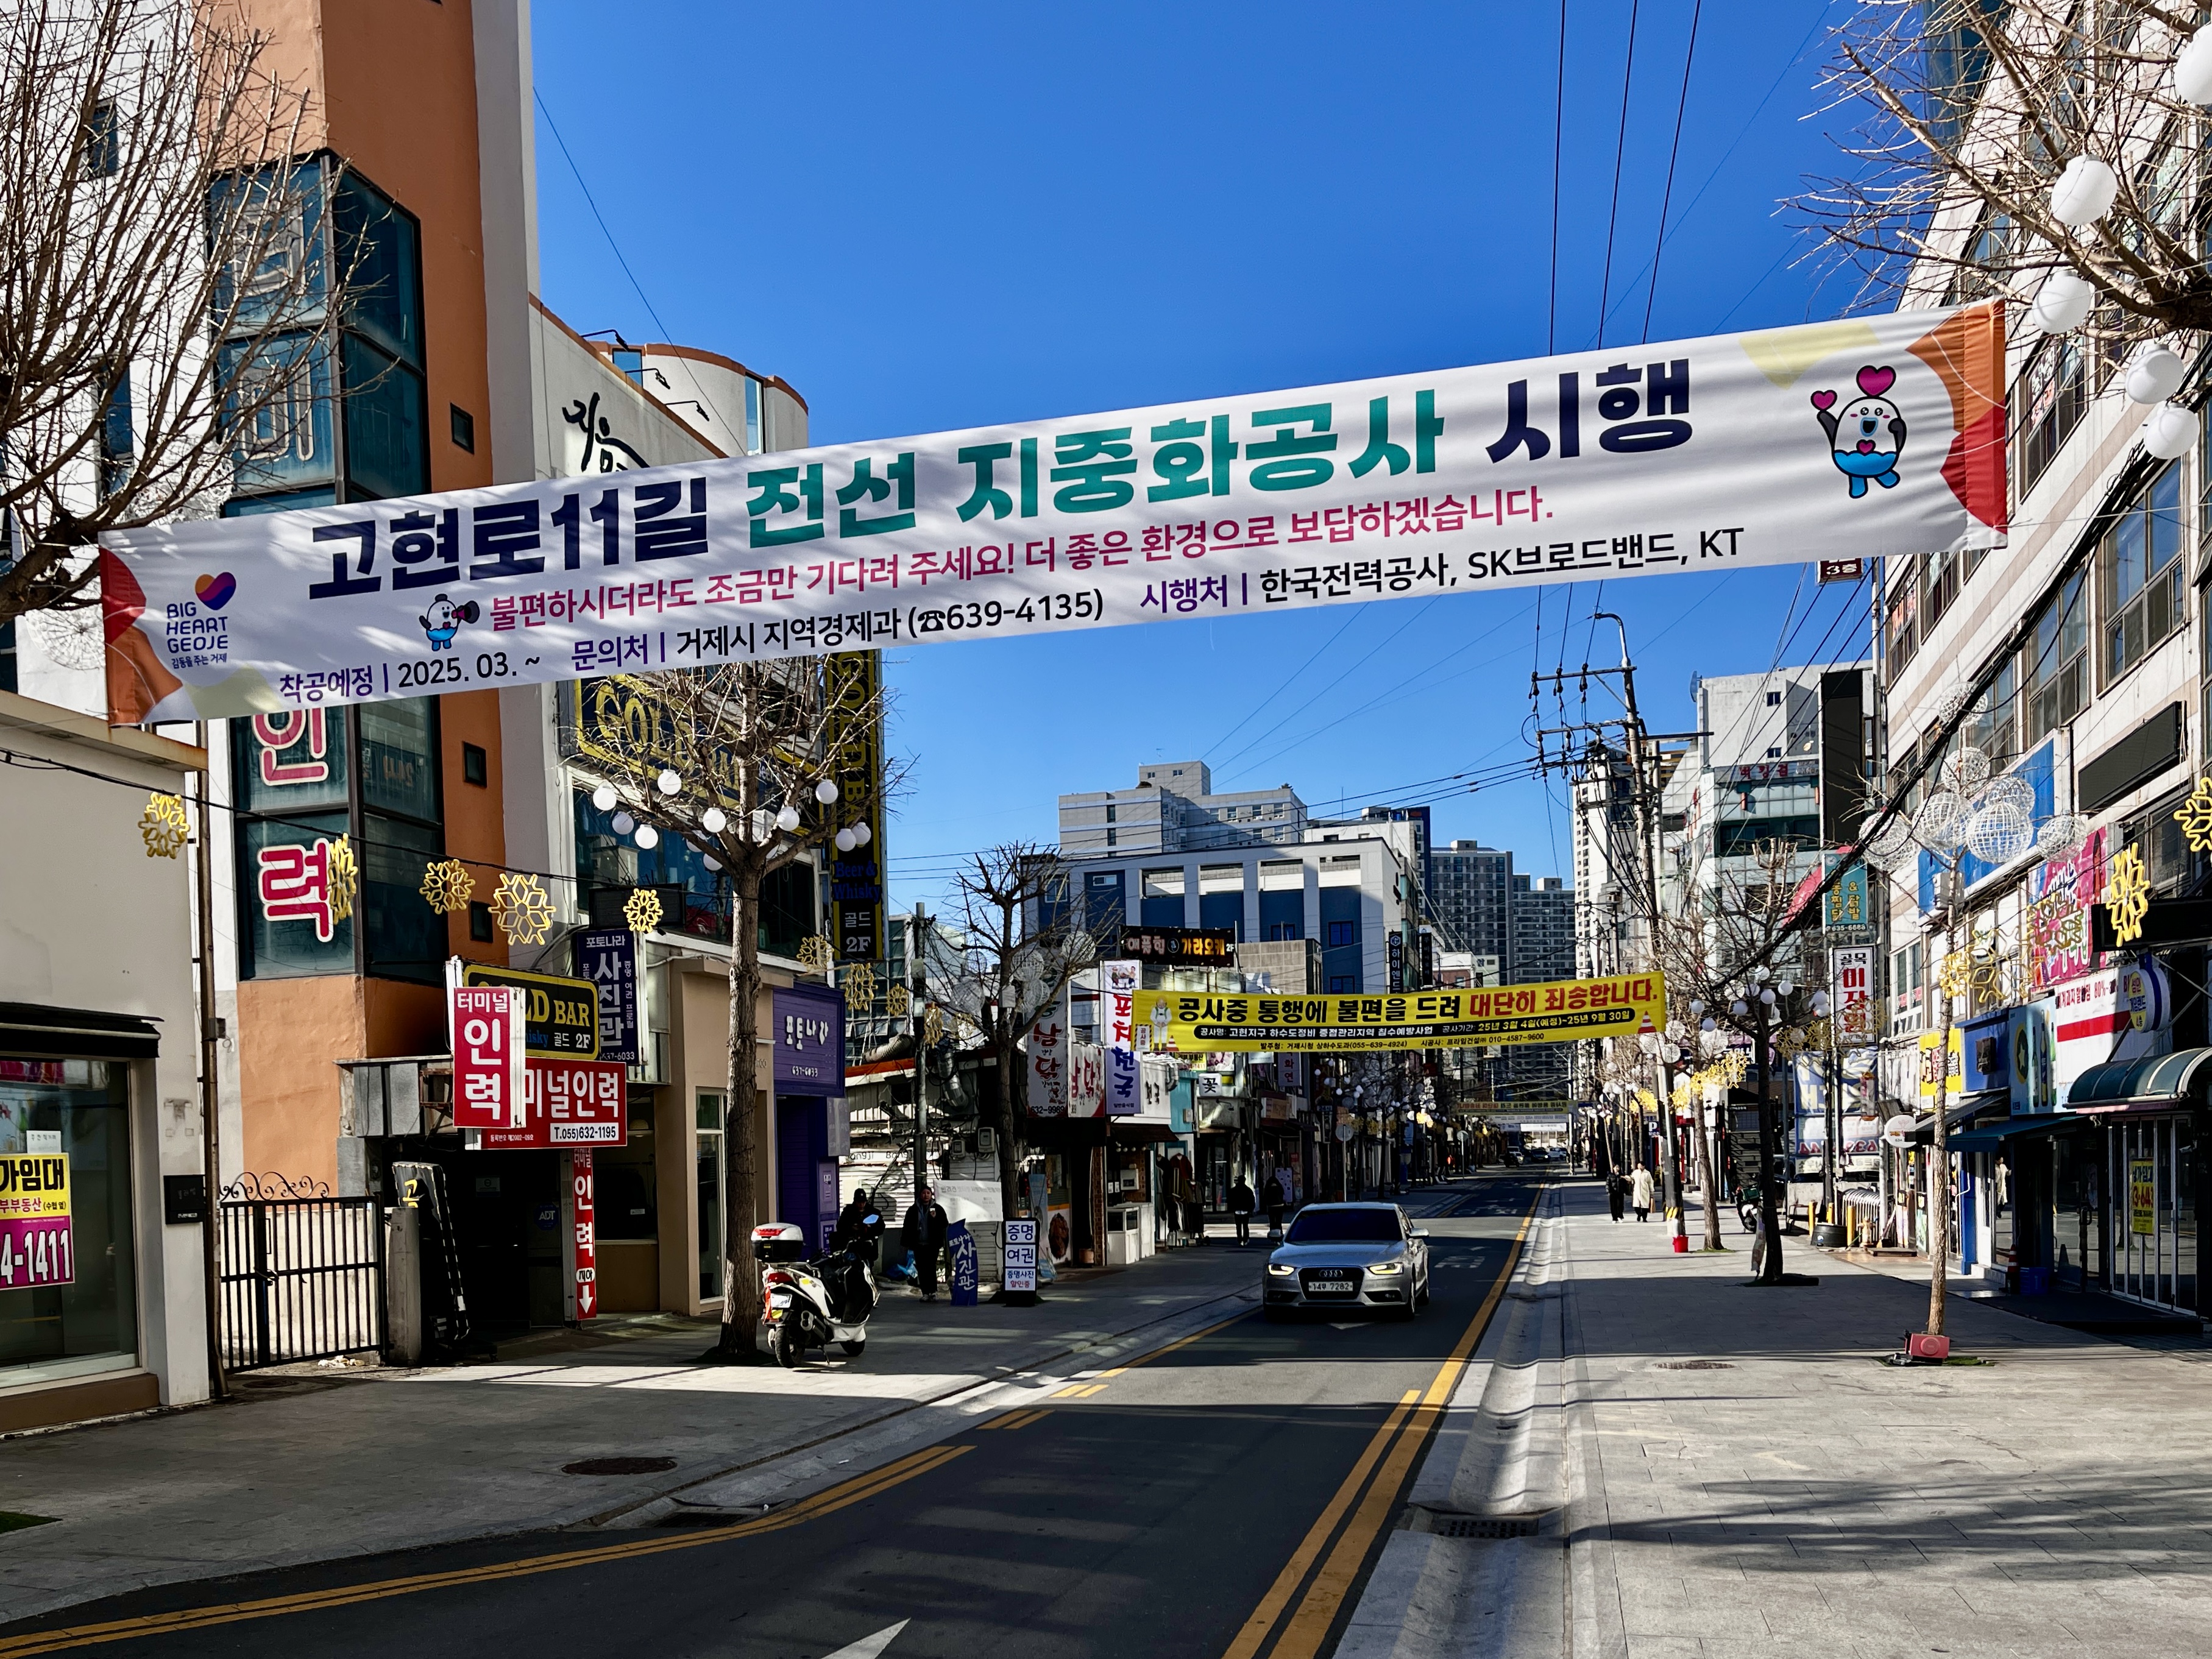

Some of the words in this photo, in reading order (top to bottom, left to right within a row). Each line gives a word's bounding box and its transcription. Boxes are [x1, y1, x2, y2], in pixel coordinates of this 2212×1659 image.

[309, 477, 708, 600] 고현로11길
[746, 452, 916, 548] 전선
[957, 389, 1445, 523] 지중화공사
[1486, 358, 1693, 464] 시행
[489, 578, 697, 632] 불편하시더라도
[704, 564, 798, 605] 조금만
[807, 554, 899, 595] 기다려
[908, 542, 1014, 587] 주세요!
[1026, 536, 1055, 571] 더
[1066, 529, 1132, 569] 좋은
[1141, 515, 1278, 562] 환경으로
[1288, 485, 1553, 545] 보답하겠습니다.
[167, 602, 196, 618] BIG
[280, 668, 372, 703] 착공예정
[398, 658, 469, 688] 2025.
[477, 653, 518, 679] 03.
[571, 635, 649, 671] 문의처
[678, 621, 755, 658] 거제시
[764, 608, 901, 649] 지역경제과
[1140, 574, 1227, 614] 시행처
[1260, 552, 1458, 603] 한국전력공사,
[1468, 532, 1687, 579] SK브로드밴드,
[1698, 528, 1745, 558] KT
[167, 616, 227, 635] HEART
[168, 635, 228, 654] GEOJE
[194, 655, 208, 667] 주는
[210, 652, 227, 663] 거제
[834, 862, 861, 879] Beer
[834, 883, 881, 903] Whisky
[845, 912, 871, 927] 골드
[586, 935, 625, 948] 포토나라
[846, 937, 871, 952] 2F
[1182, 938, 1225, 956] 가라오케
[1840, 953, 1866, 966] 골목
[1392, 949, 1400, 990] 하이엔드
[458, 992, 508, 1013] 터미널
[595, 952, 624, 1046] 사진관
[1179, 997, 1247, 1022] 공사중
[1258, 999, 1328, 1023] 통행에
[1338, 998, 1406, 1022] 불편을
[1416, 996, 1460, 1019] 드려
[1470, 991, 1536, 1016] 대단히
[1545, 979, 1657, 1011] 죄송합니다.
[555, 1002, 590, 1027] BAR
[1230, 1028, 1266, 1038] 고현지구
[1270, 1028, 1316, 1038] 하수도정비
[1319, 1028, 1375, 1038] 중점관리지역
[1378, 1026, 1433, 1036] 침수예방사업
[1478, 1023, 1500, 1031] 25년
[1503, 1021, 1517, 1030] 3월
[1592, 1013, 1606, 1023] 9월
[1609, 1010, 1630, 1021] 30일
[554, 1033, 569, 1047] 골드
[576, 1034, 590, 1048] 2F
[1489, 1033, 1545, 1043] 010-4587-9600
[464, 1019, 502, 1120] 인력
[792, 1065, 819, 1078] 637-6033
[526, 1069, 619, 1119] 미널인력
[1202, 1077, 1218, 1093] 꽃
[1030, 1105, 1065, 1114] 632-9989
[555, 1127, 616, 1141] T.055)632-1195
[0, 1159, 64, 1192] 가임대
[402, 1179, 420, 1208] 고
[0, 1197, 42, 1213] 부부동산
[539, 1210, 556, 1220] ADT
[574, 1175, 594, 1257] 인력
[1008, 1225, 1033, 1241] 증명
[1, 1229, 71, 1284] 4-1411
[1007, 1248, 1033, 1264] 여권
[957, 1242, 977, 1290] 사진관
[1007, 1270, 1034, 1279] 증명사진
[1330, 1282, 1350, 1290] 7282
